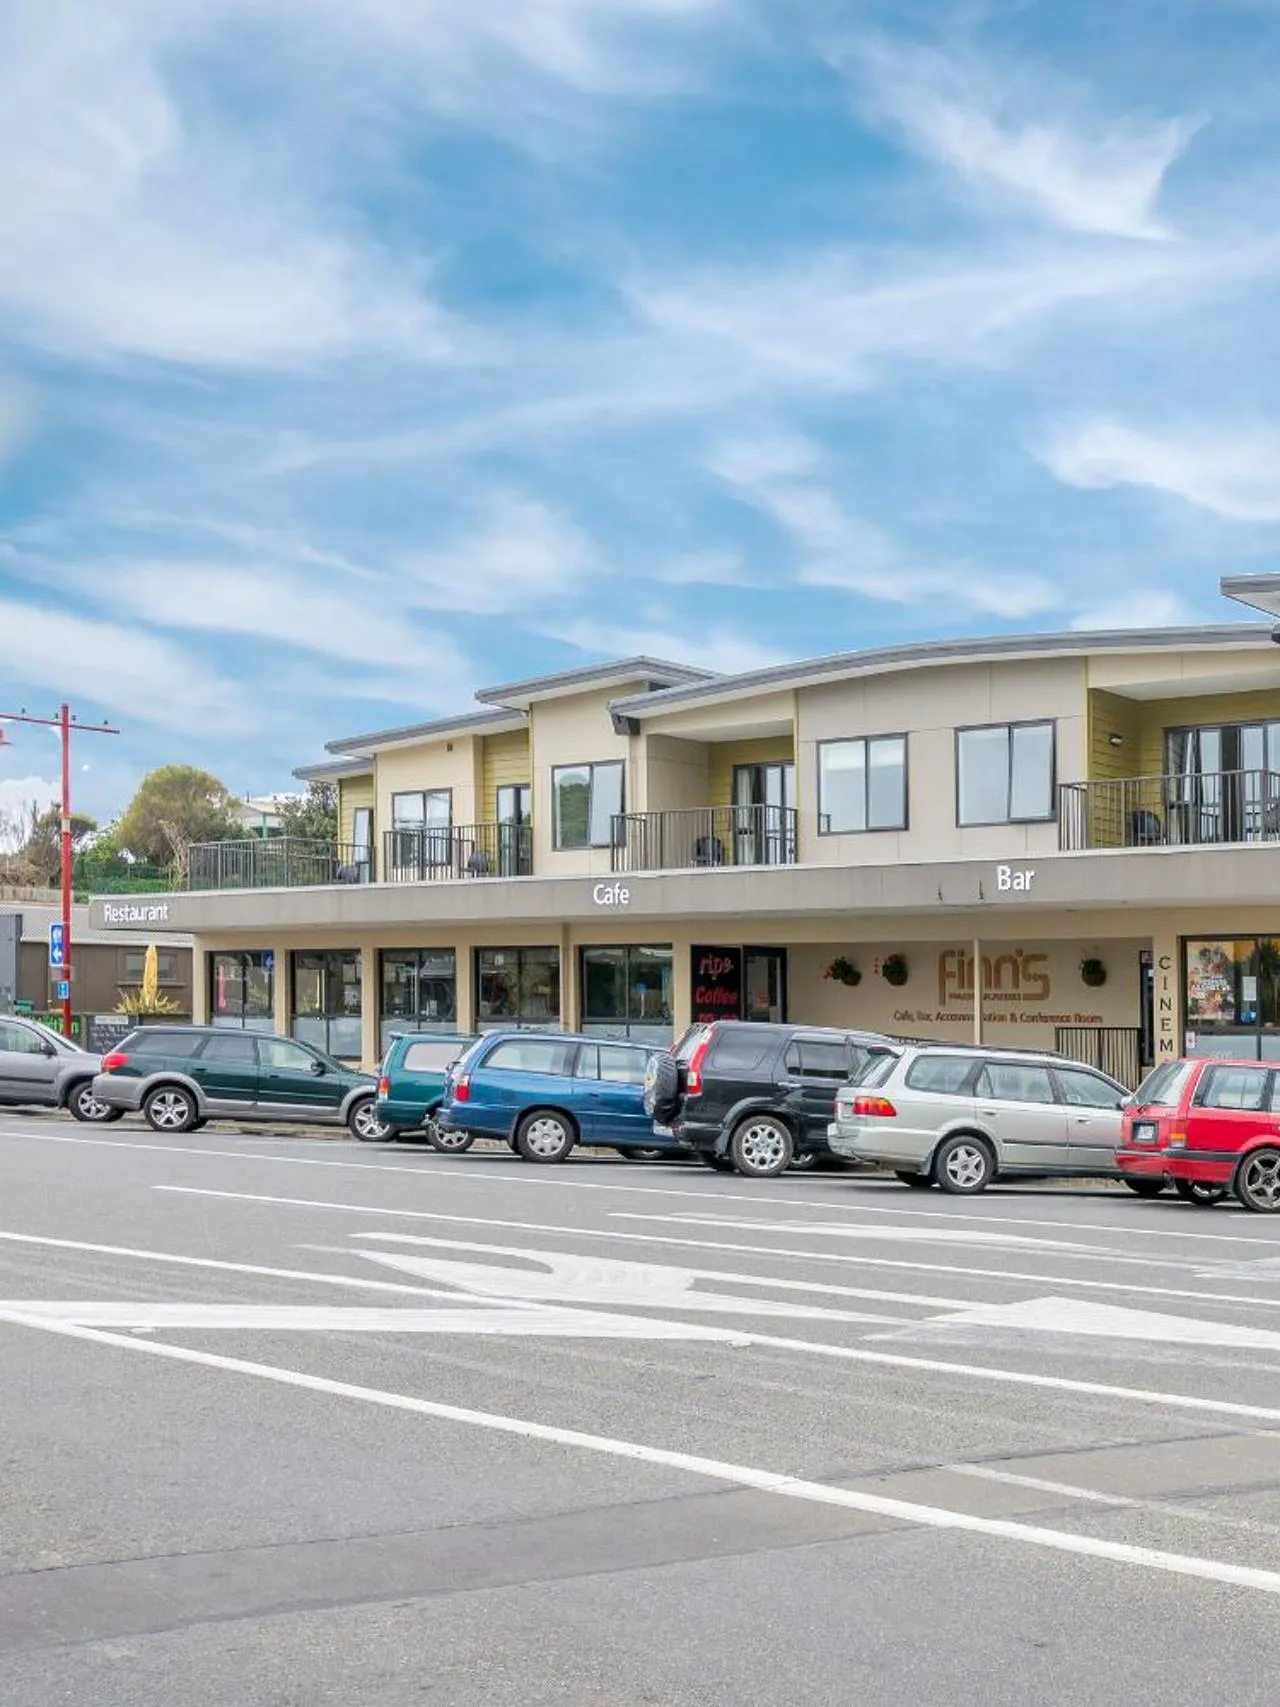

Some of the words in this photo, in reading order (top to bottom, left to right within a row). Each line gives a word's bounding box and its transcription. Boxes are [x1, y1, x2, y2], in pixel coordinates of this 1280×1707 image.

[997, 864, 1035, 891] Bar
[593, 883, 630, 905] Cafe
[104, 903, 168, 922] Restaurant
[1158, 956, 1173, 1061] CINEM
